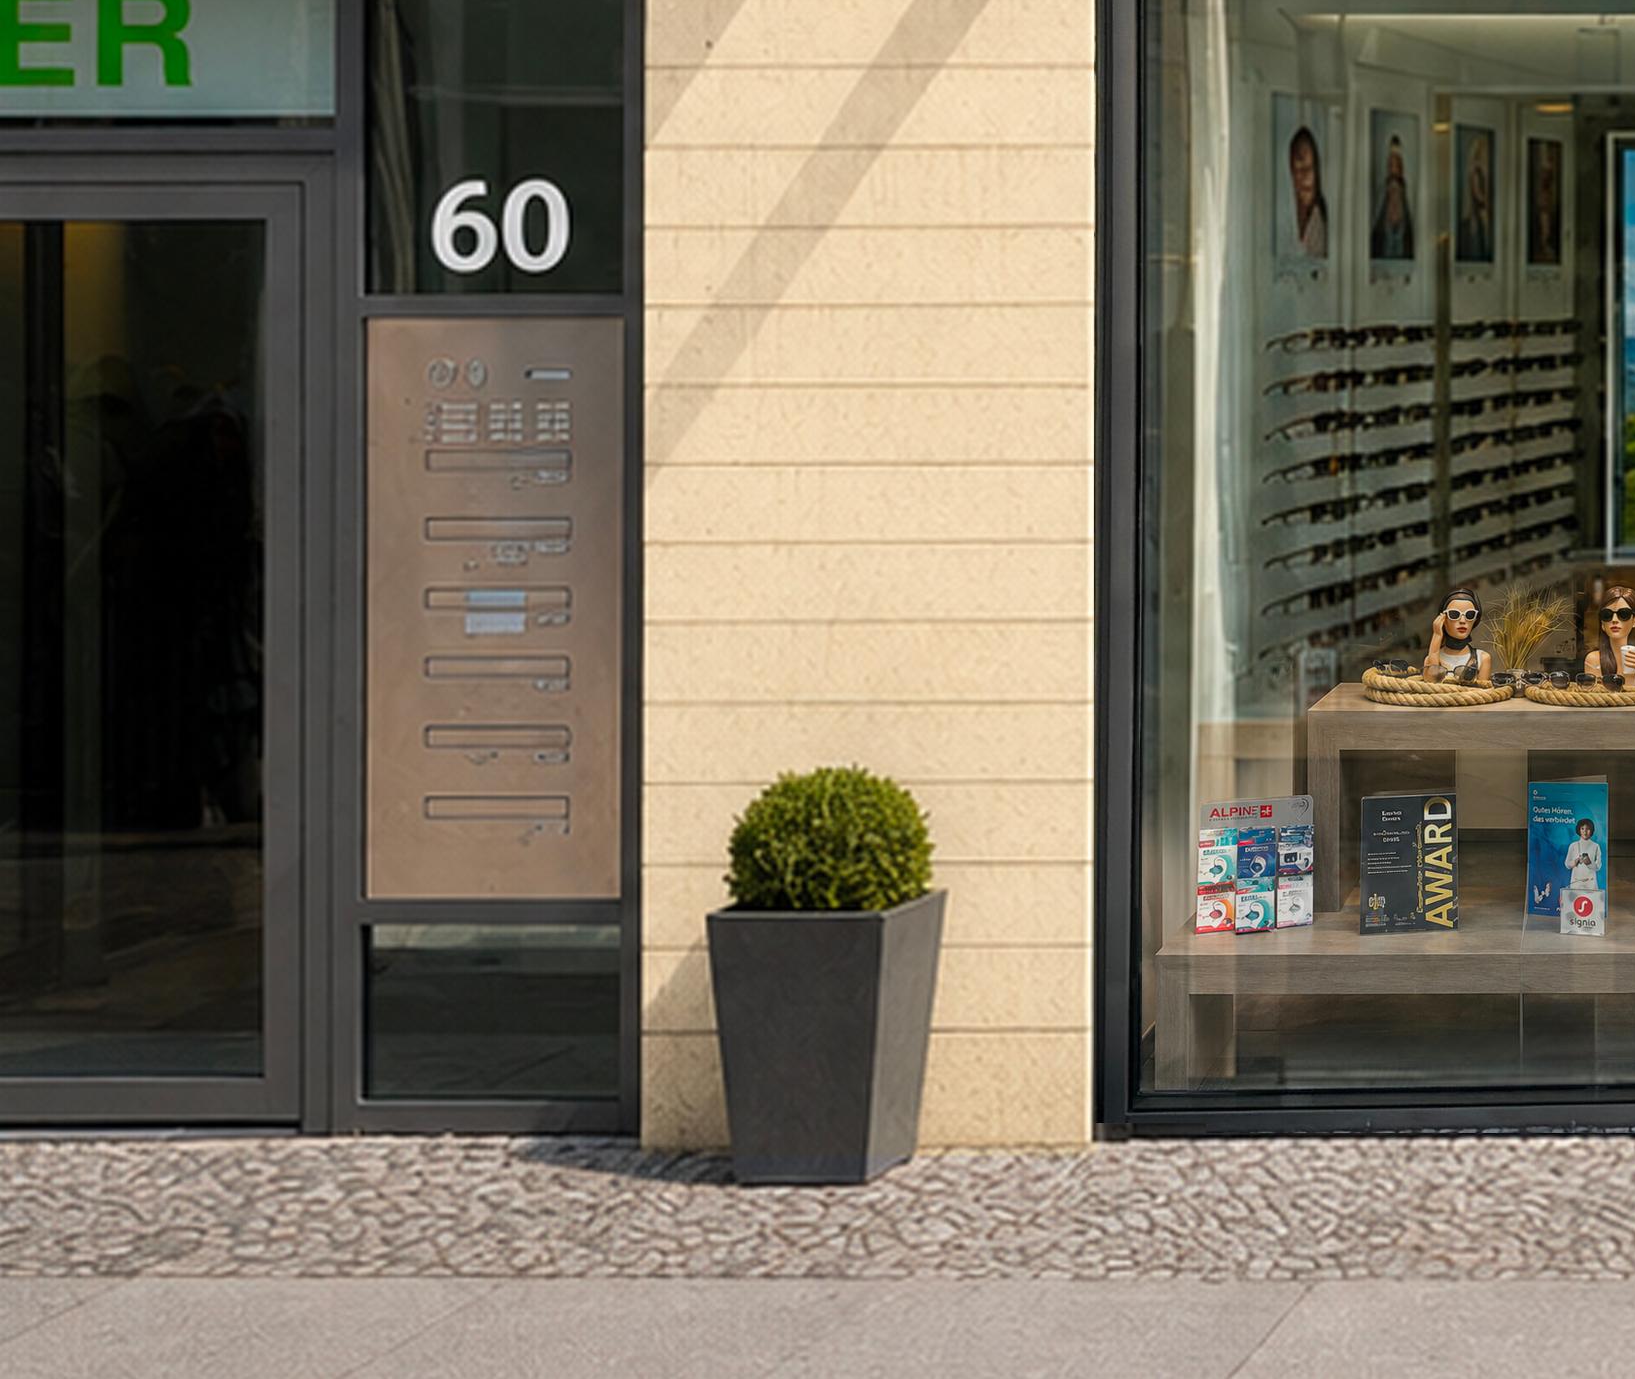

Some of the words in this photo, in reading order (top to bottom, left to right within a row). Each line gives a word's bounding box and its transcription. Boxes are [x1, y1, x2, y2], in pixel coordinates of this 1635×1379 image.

[431, 178, 570, 274] 60
[1210, 806, 1259, 818] ALPINE
[1424, 797, 1454, 928] AWARD
[1569, 918, 1596, 928] signia
